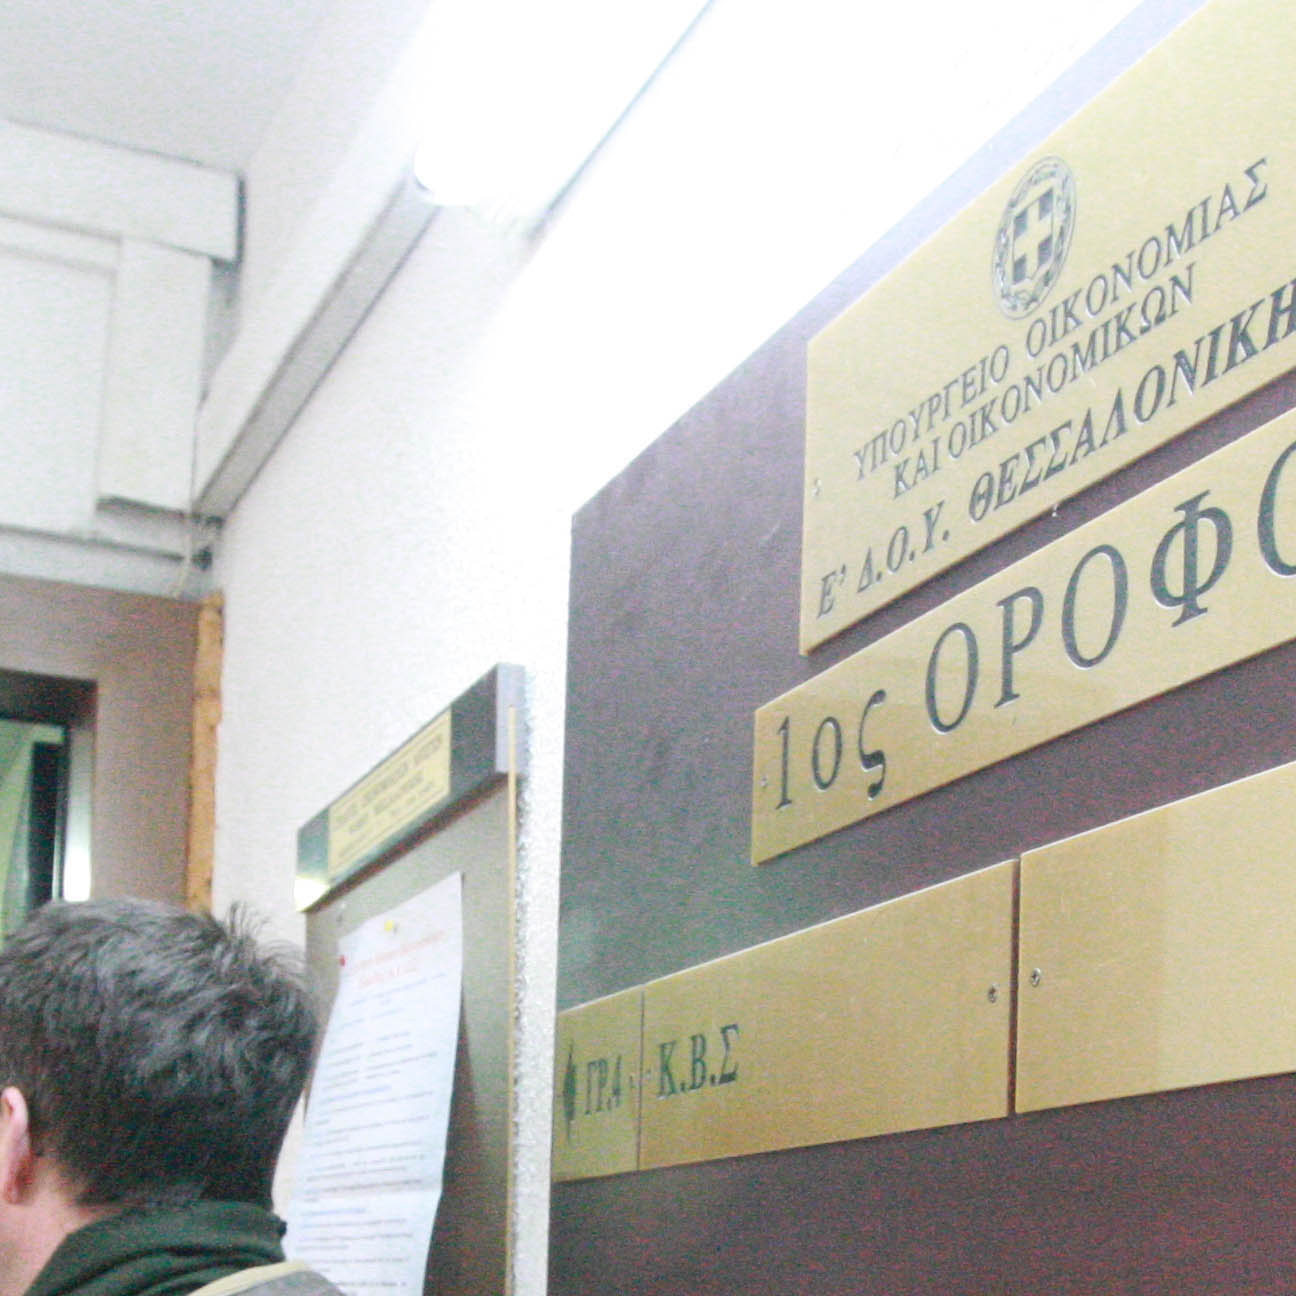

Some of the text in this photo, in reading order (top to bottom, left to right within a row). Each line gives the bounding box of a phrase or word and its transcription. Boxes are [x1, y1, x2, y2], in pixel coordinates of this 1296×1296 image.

[854, 157, 1268, 482] ΥΠΟΥΡΓΕΙΟ ΟΙΚΟΝΟΜΙΑΣ
[893, 261, 1197, 500] ΚΑΙ ΟΙΚΟΝΟΜΙΚΩΝ
[857, 500, 950, 595] Δ.Ο.Υ.
